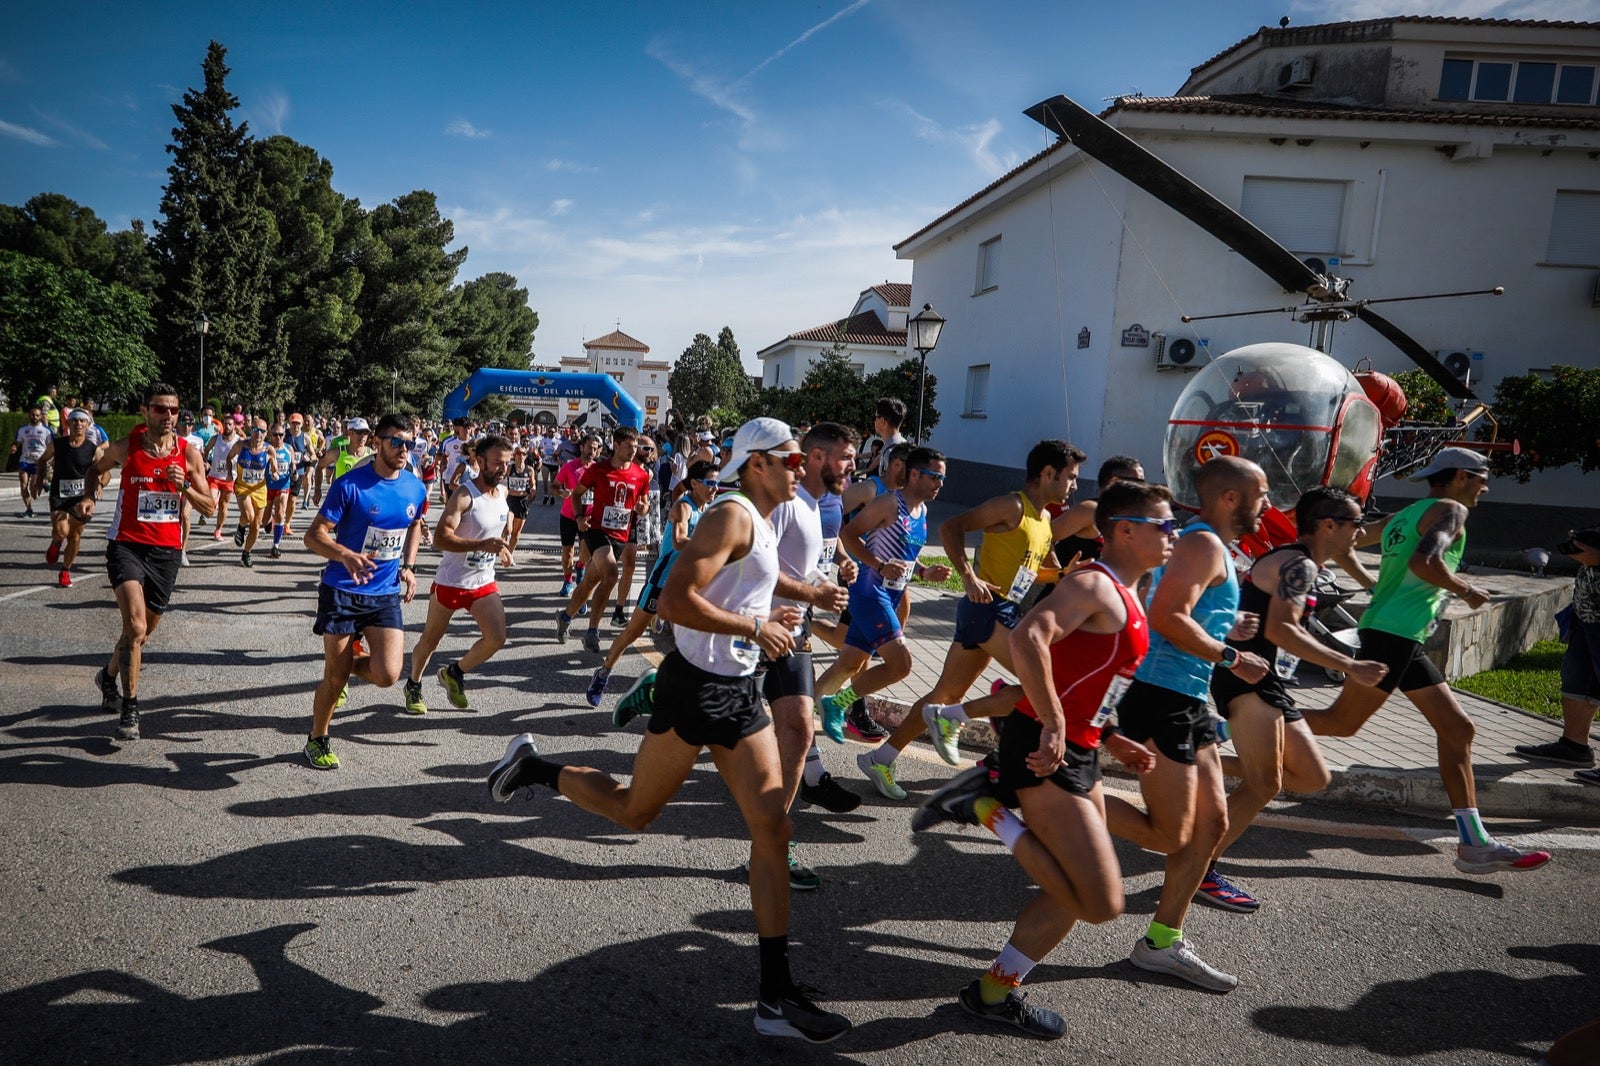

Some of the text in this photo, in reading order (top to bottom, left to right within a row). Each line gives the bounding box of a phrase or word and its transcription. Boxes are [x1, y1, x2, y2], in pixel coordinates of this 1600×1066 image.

[500, 385, 538, 394] EJÉRCITO
[154, 499, 178, 510] 319
[613, 512, 628, 521] 245
[381, 536, 401, 548] 331
